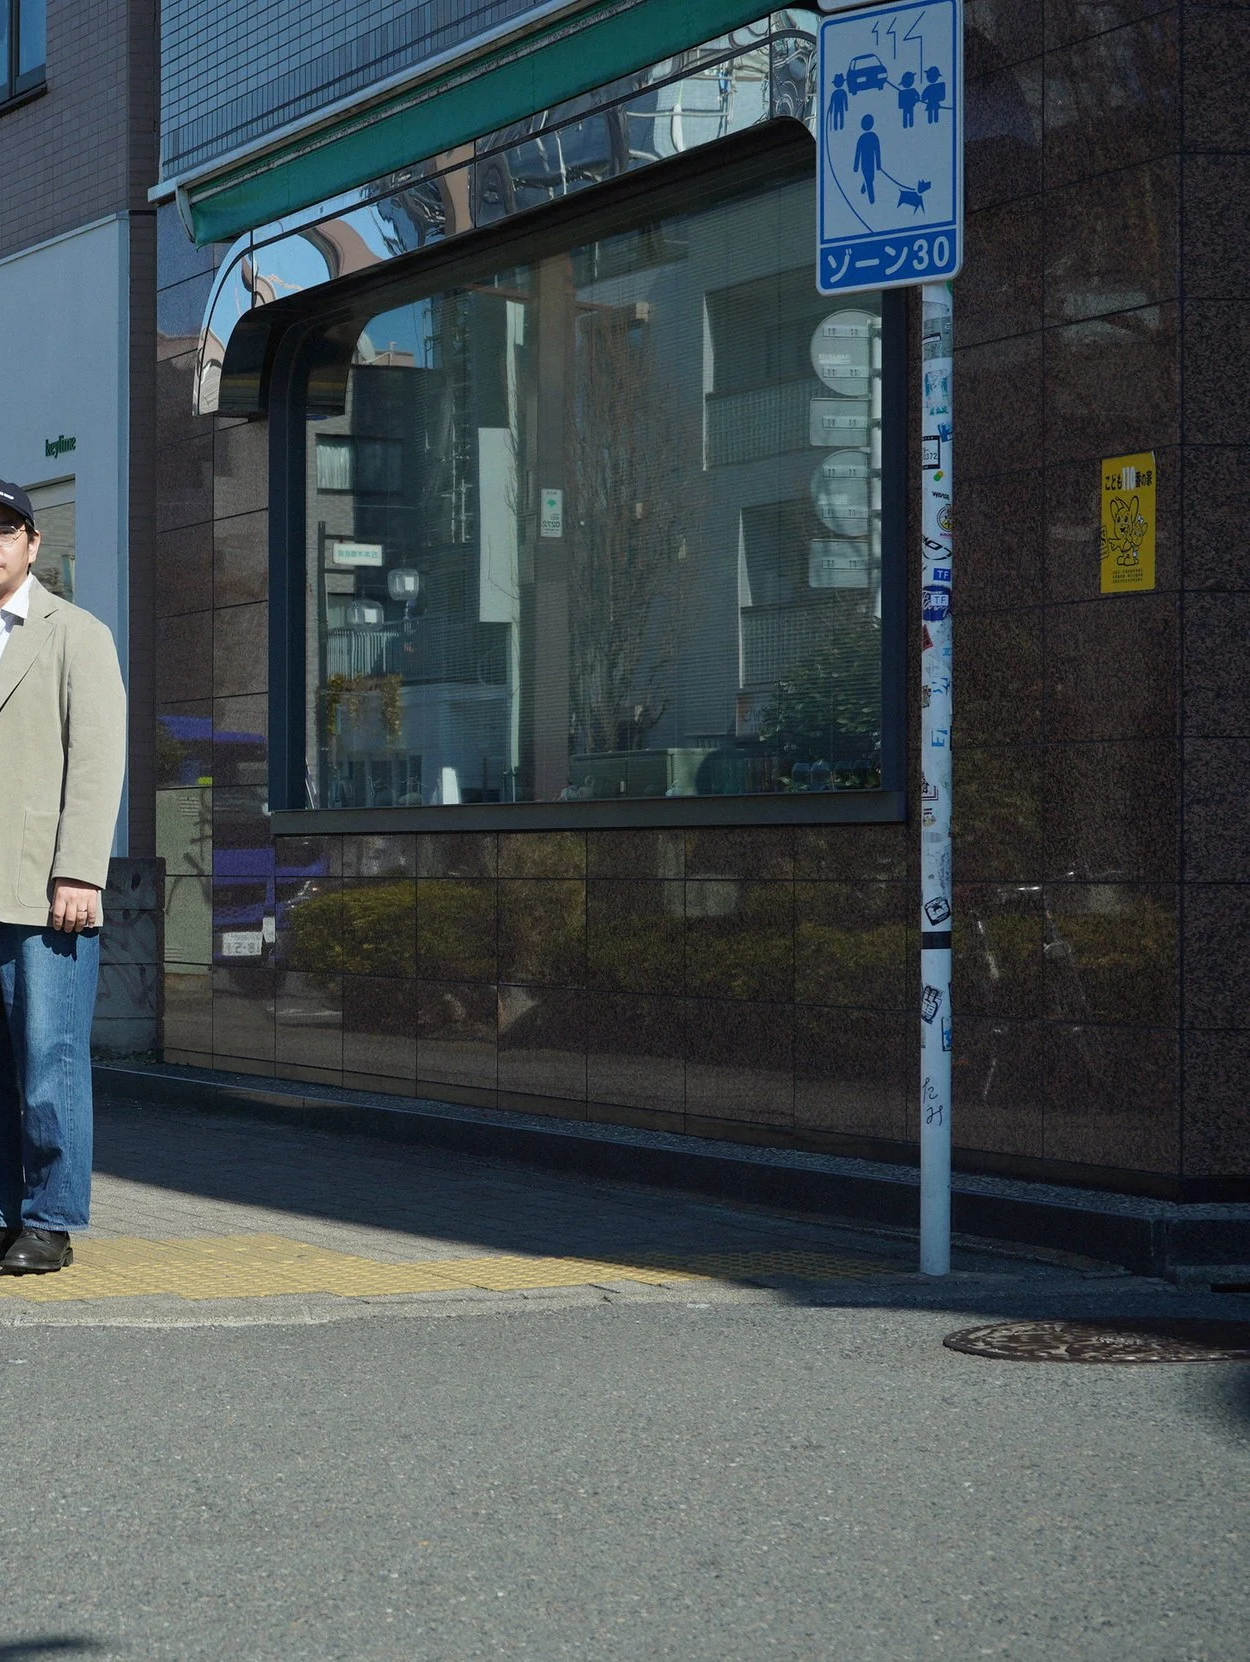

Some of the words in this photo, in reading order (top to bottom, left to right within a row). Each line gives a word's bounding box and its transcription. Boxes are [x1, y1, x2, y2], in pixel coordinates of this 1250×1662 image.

[828, 235, 950, 284] ゾーン30
[937, 570, 950, 579] TF
[934, 596, 946, 605] TF
